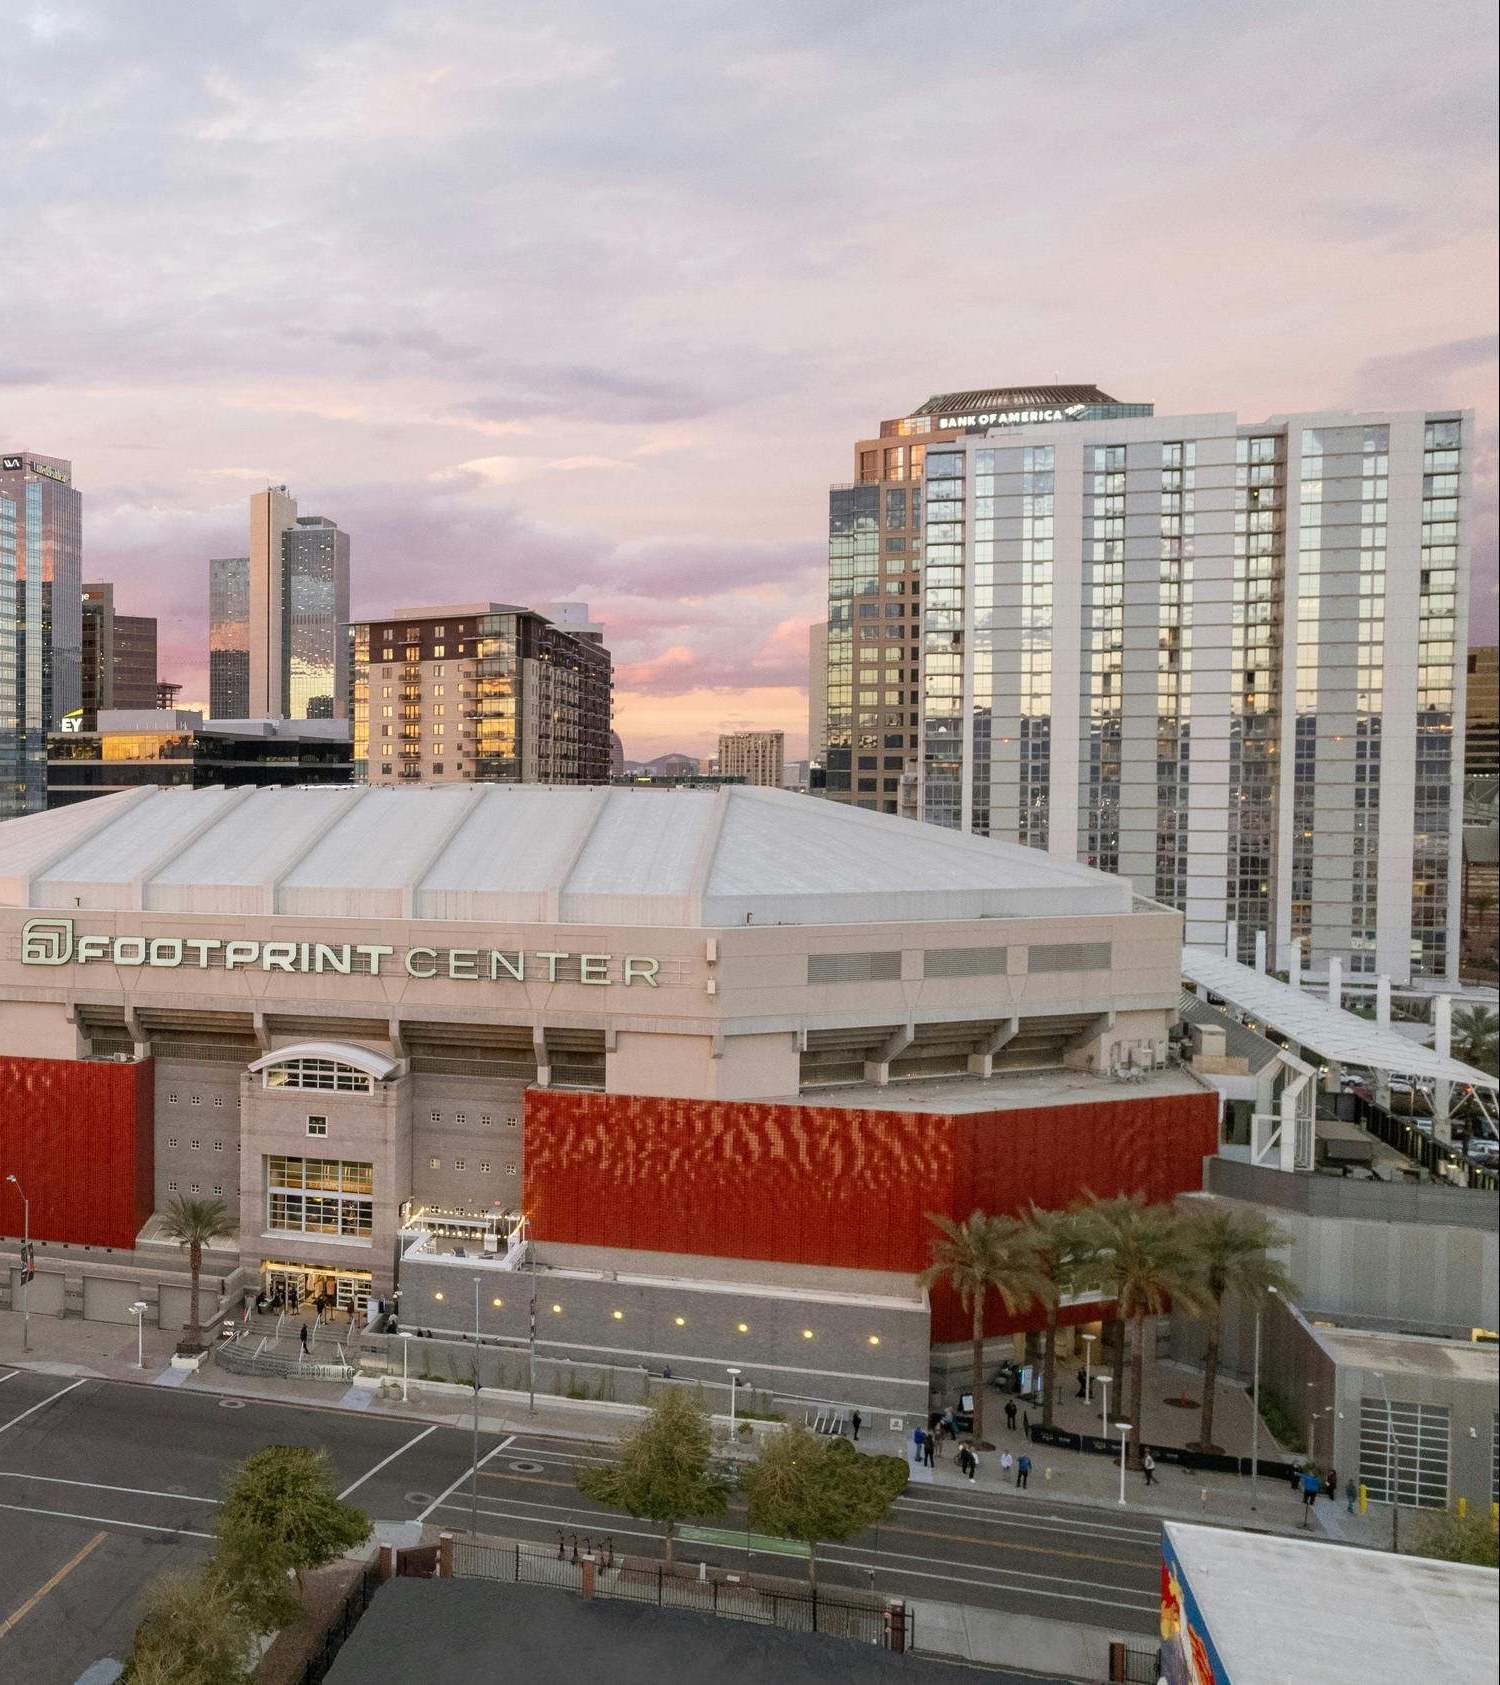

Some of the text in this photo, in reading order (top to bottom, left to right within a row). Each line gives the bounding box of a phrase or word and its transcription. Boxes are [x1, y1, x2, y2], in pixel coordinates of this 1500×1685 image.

[939, 410, 1062, 429] BANK OF AMERICA
[61, 717, 83, 733] EY
[77, 934, 661, 988] FOOTPRINT CENTER
